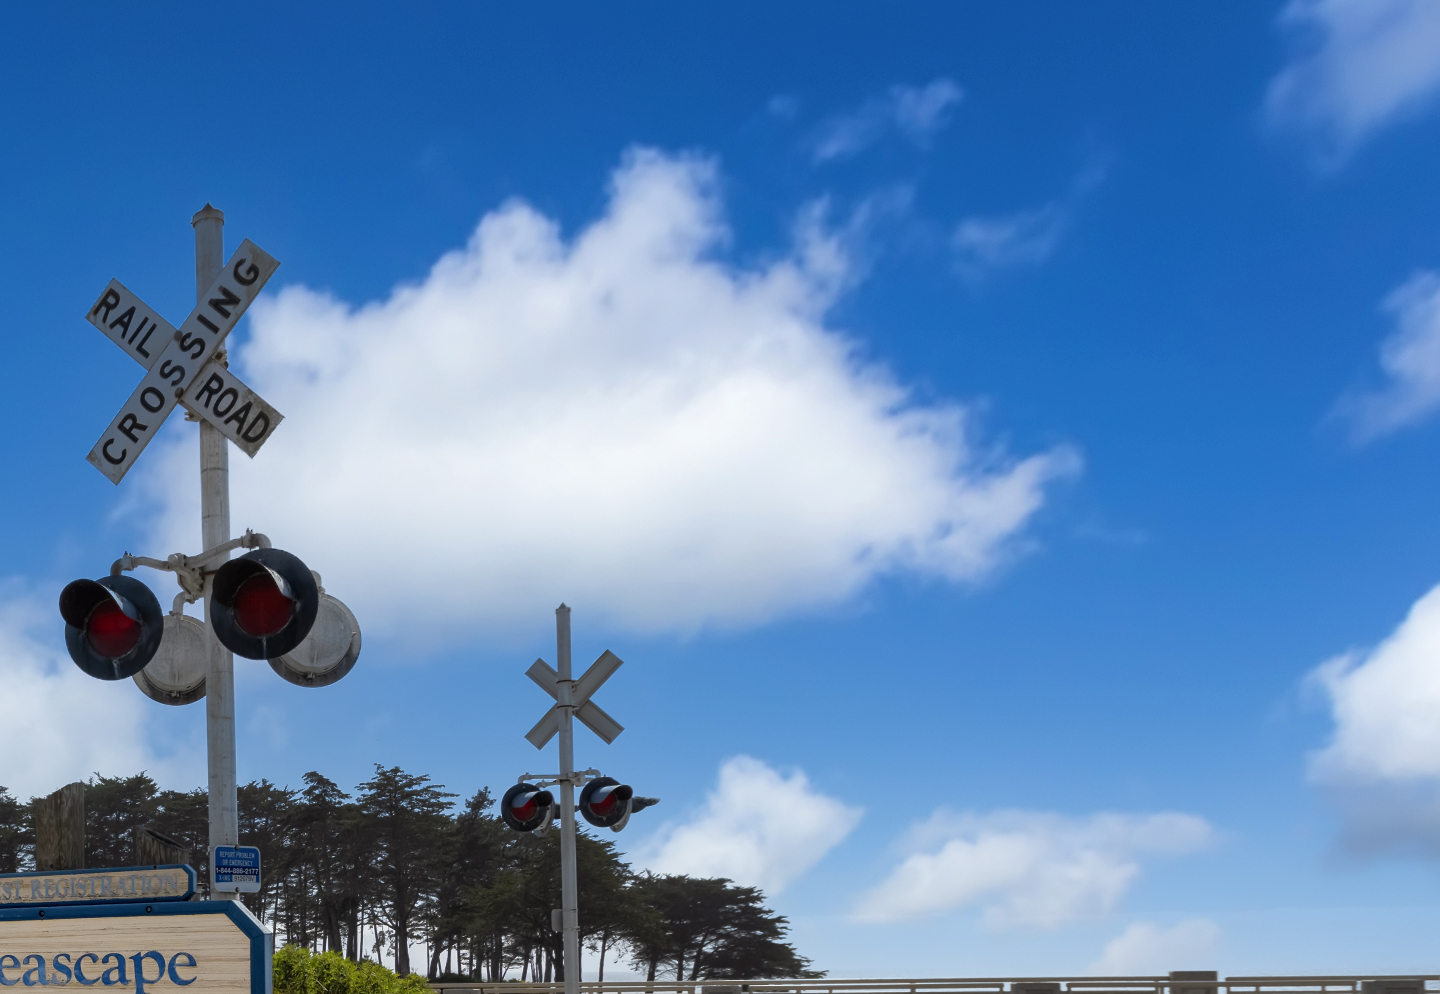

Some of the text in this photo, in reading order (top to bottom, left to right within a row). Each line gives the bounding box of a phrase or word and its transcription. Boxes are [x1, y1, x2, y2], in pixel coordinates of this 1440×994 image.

[93, 287, 270, 444] RAIL ROAD
[102, 257, 260, 465] CROSSING
[29, 871, 179, 900] REGISTRATION
